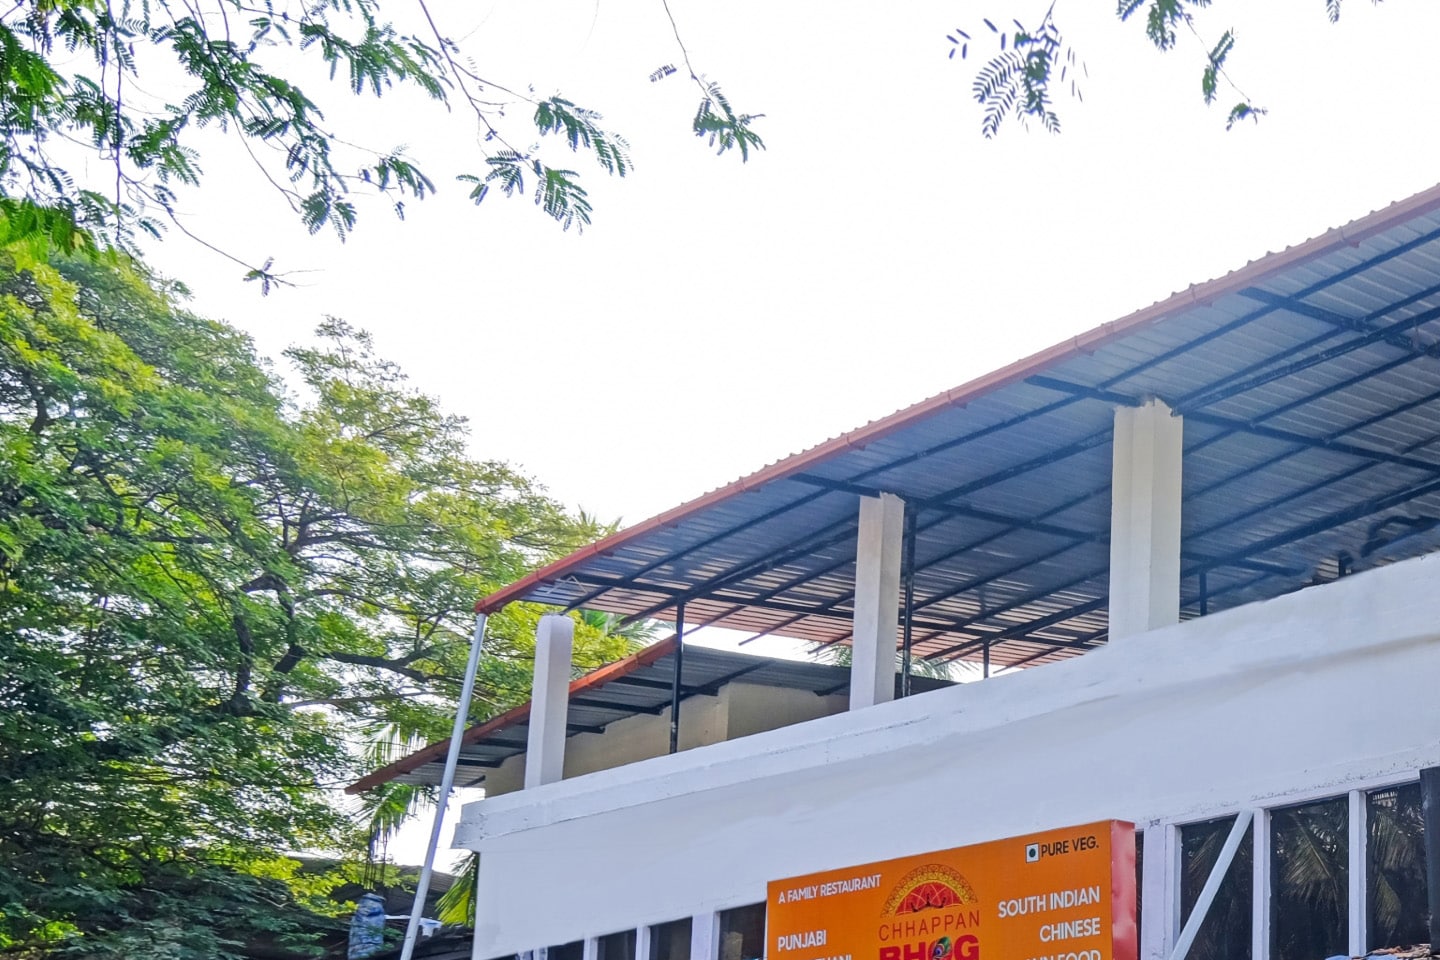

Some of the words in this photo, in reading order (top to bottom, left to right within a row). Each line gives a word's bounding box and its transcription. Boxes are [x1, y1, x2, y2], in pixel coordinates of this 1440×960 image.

[1041, 840, 1069, 857] PURE
[1072, 835, 1099, 852] VEG.
[778, 891, 786, 904] A
[787, 885, 819, 903] FAMILY
[820, 874, 882, 897] RESTAURANT
[998, 894, 1047, 919] SOUTH
[1050, 885, 1100, 911] INDIAN
[878, 909, 980, 941] CHHAPPAN
[1039, 917, 1101, 942] CHINESE
[777, 929, 827, 952] PUNJABI
